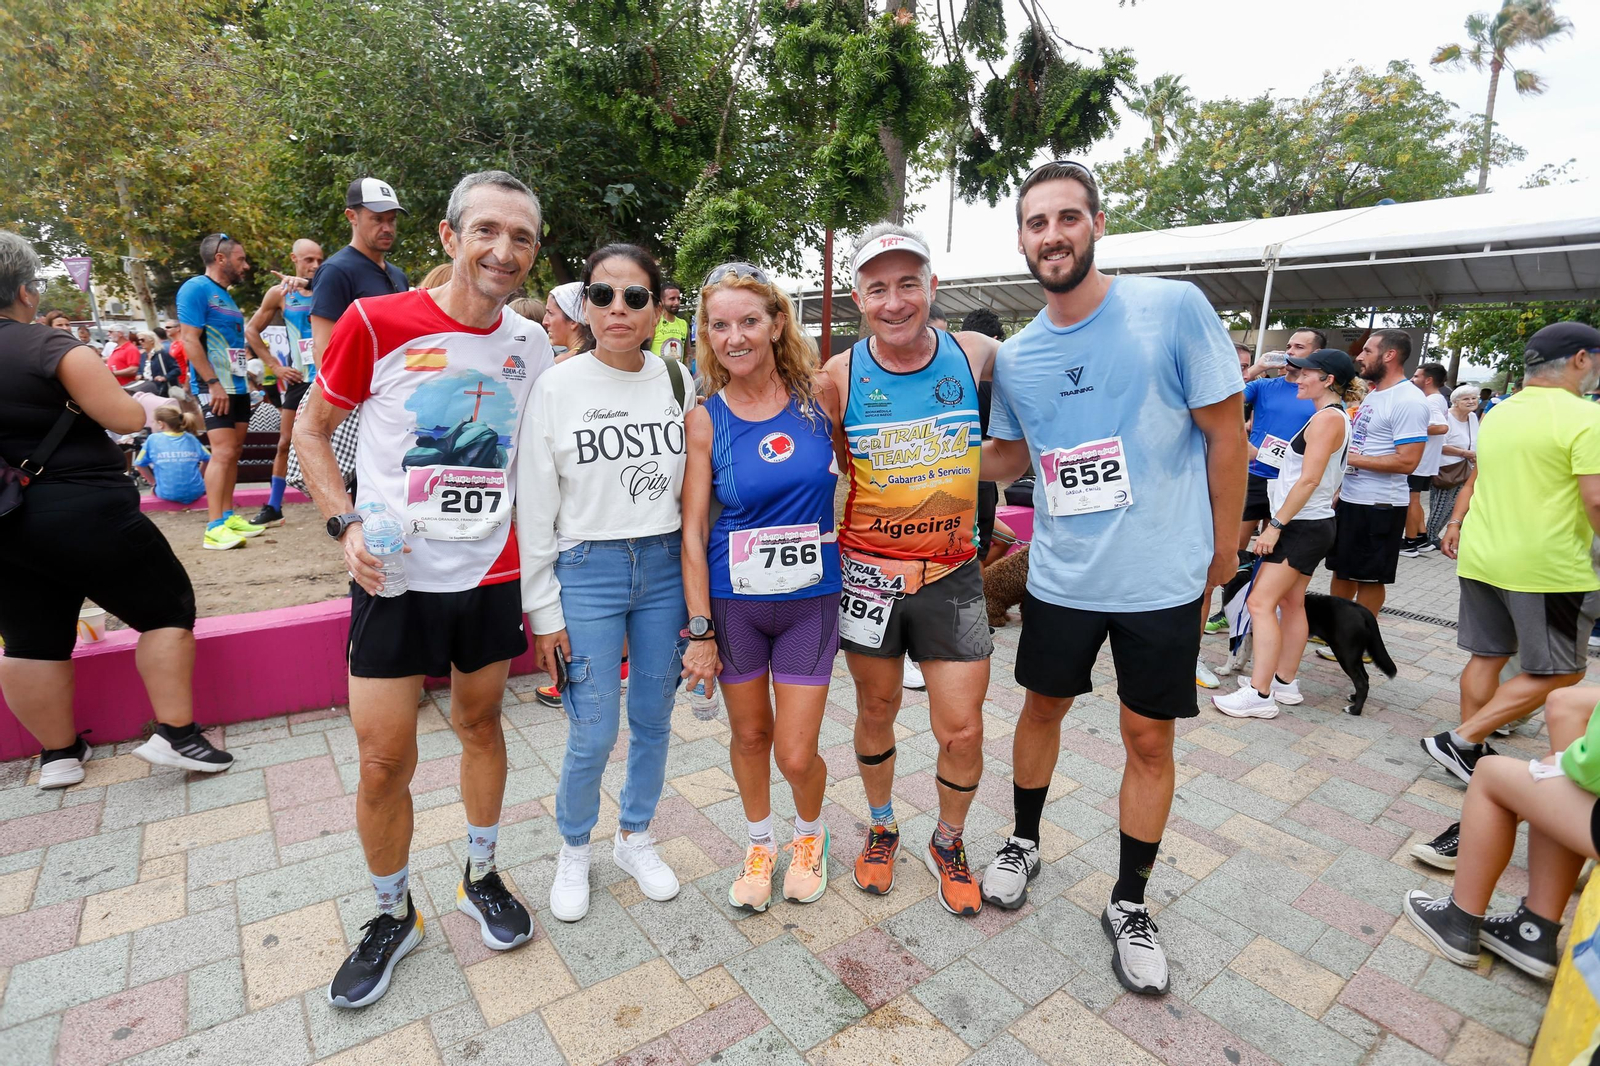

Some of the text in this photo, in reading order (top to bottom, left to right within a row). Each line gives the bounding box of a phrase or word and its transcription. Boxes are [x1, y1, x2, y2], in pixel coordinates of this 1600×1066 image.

[1060, 386, 1094, 397] TRAINING
[583, 408, 629, 422] Manhattan
[573, 421, 687, 464] BOSTO
[860, 423, 935, 451] C.D. TRAIL
[872, 446, 922, 466] TEAM
[620, 461, 672, 504] City
[888, 466, 970, 484] Gabarras & Servicios
[1060, 460, 1122, 488] 652
[441, 490, 501, 513] 207
[869, 516, 961, 539] Algeciras
[759, 544, 816, 568] 766
[849, 561, 877, 576] TRAIL
[840, 594, 884, 625] 494
